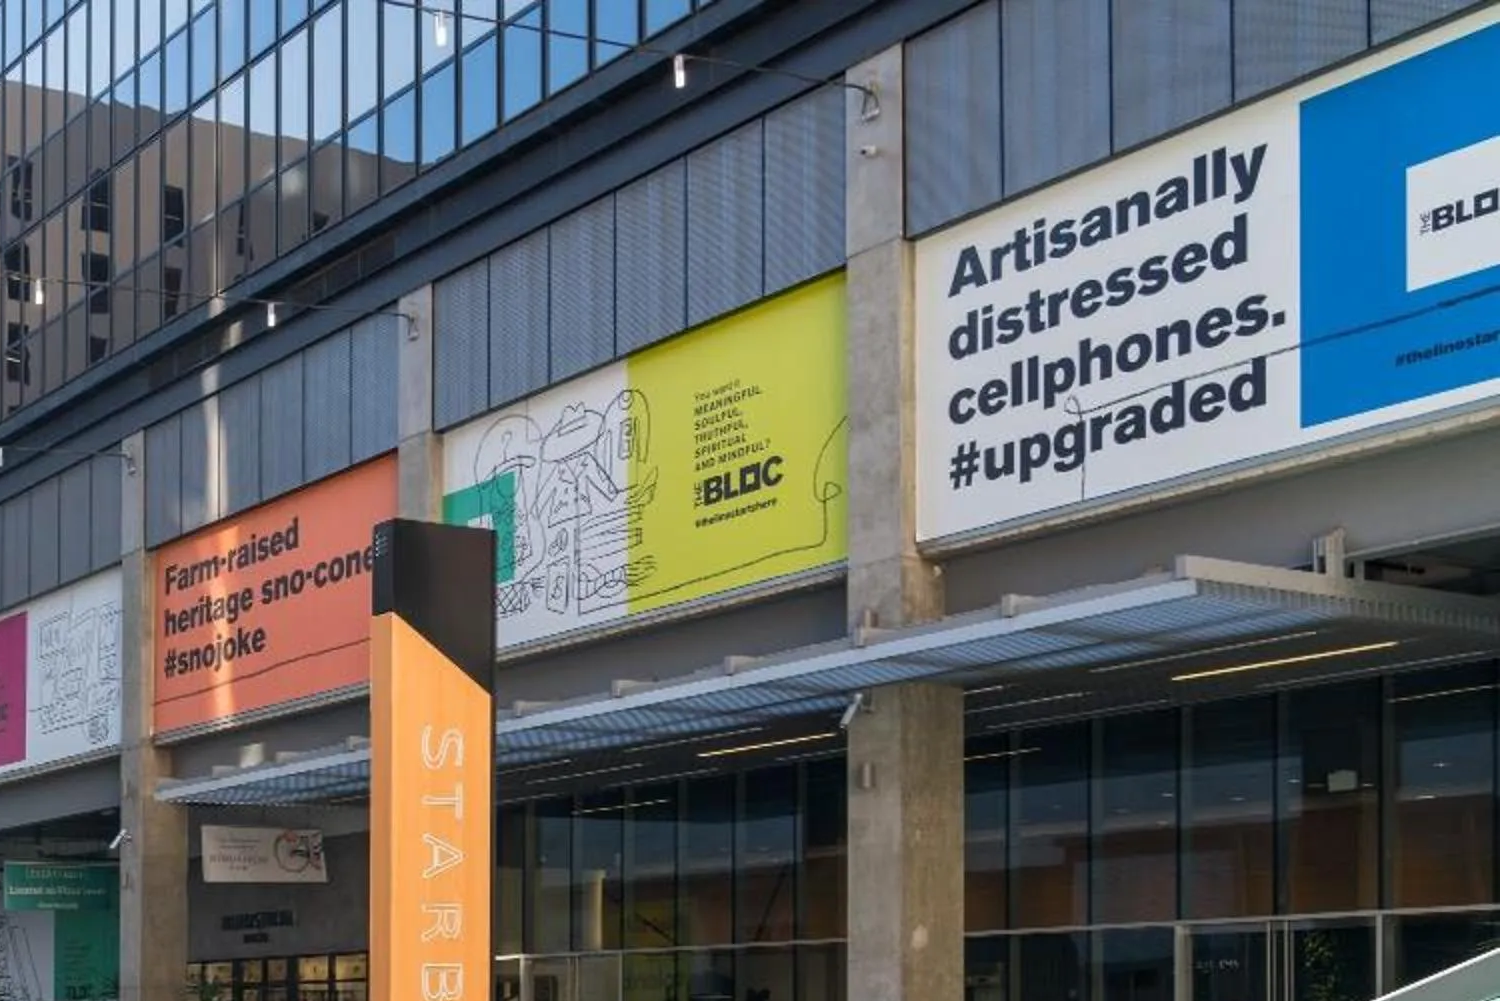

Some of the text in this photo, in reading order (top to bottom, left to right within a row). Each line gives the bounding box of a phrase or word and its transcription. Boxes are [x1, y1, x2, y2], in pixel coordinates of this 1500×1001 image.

[948, 143, 1268, 298] Artisanally
[948, 212, 1249, 361] distressed
[948, 293, 1286, 425] cellphones.
[949, 356, 1268, 490] #upgraded
[703, 455, 784, 506] BLOC
[164, 517, 300, 595] Farm-raised
[163, 586, 254, 637] heritage
[163, 626, 268, 679] #snojoke
